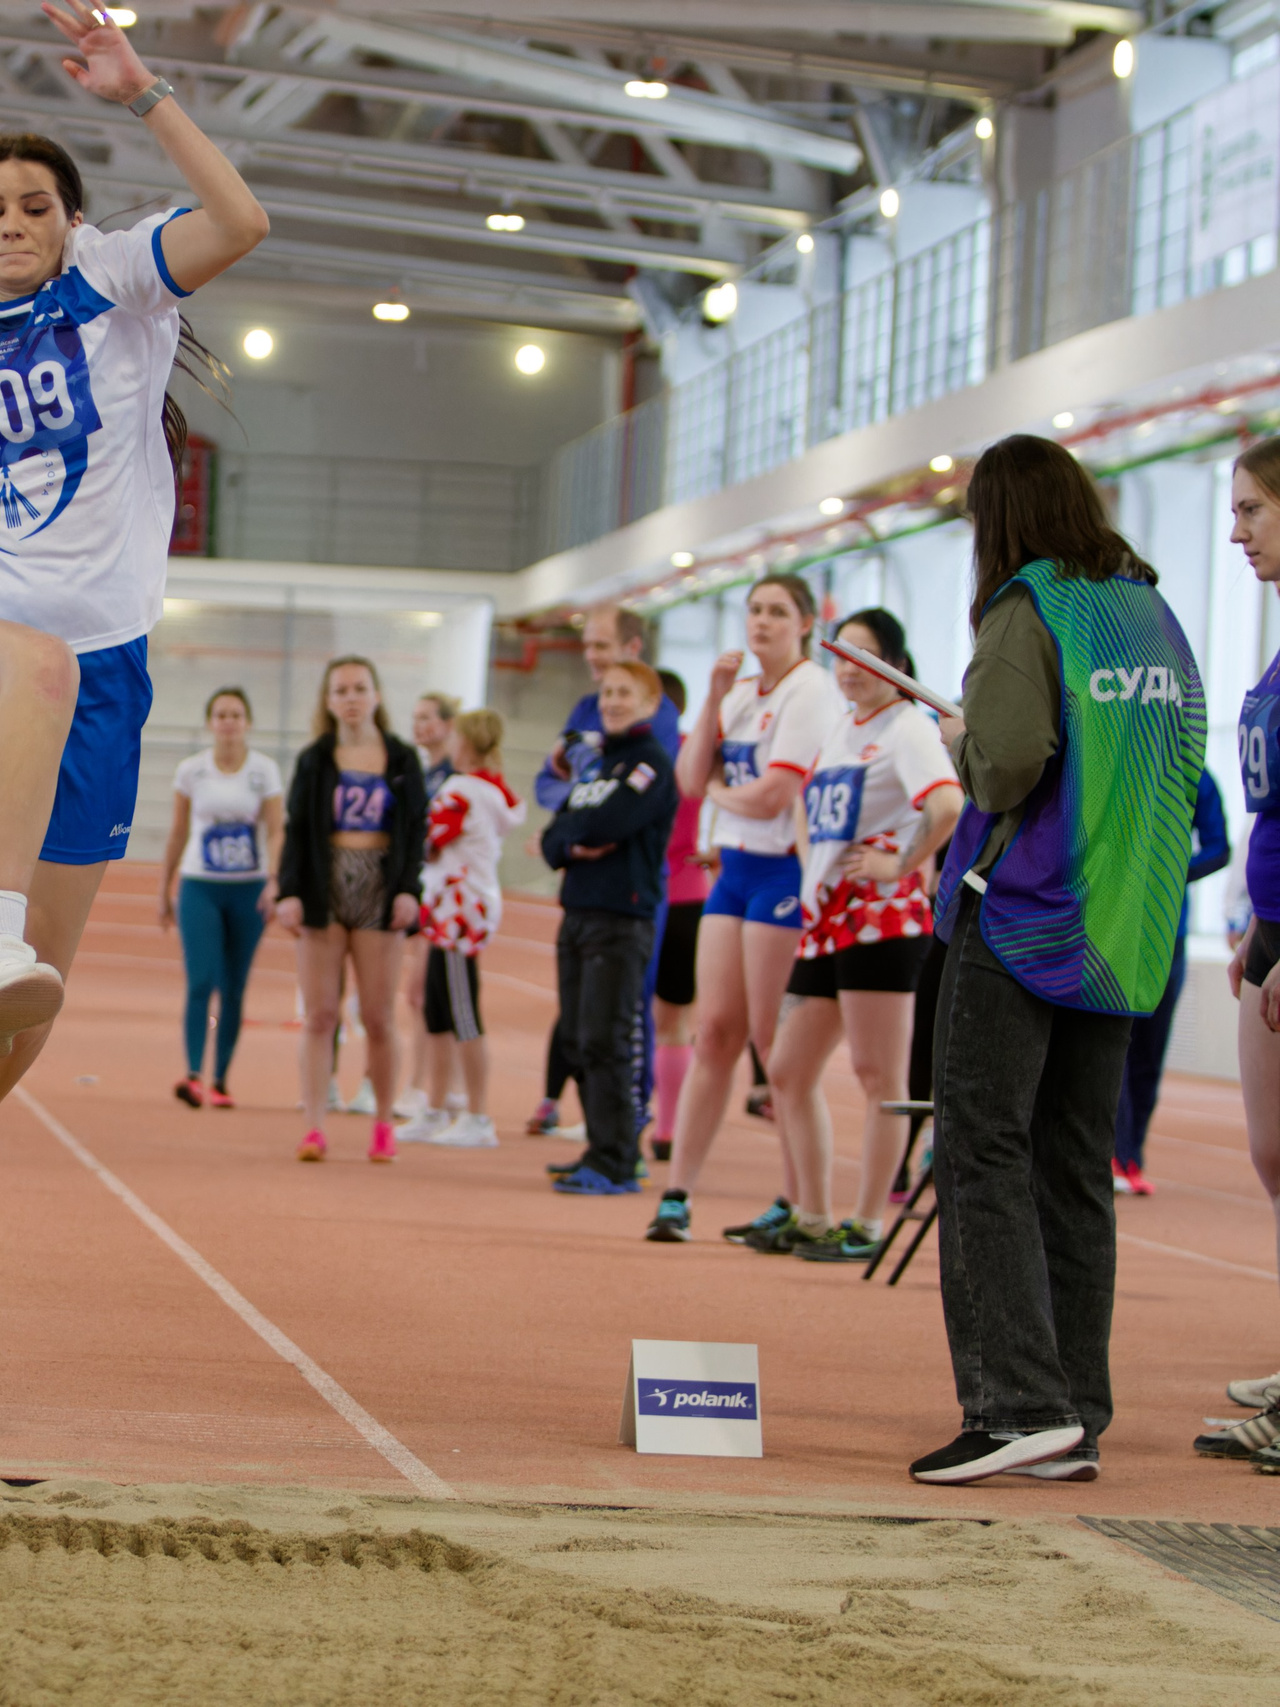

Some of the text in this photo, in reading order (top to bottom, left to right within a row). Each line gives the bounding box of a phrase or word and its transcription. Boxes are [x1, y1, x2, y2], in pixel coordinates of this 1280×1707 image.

[332, 785, 386, 824] 124
[806, 782, 852, 834] 243
[673, 1390, 749, 1409] polanik
